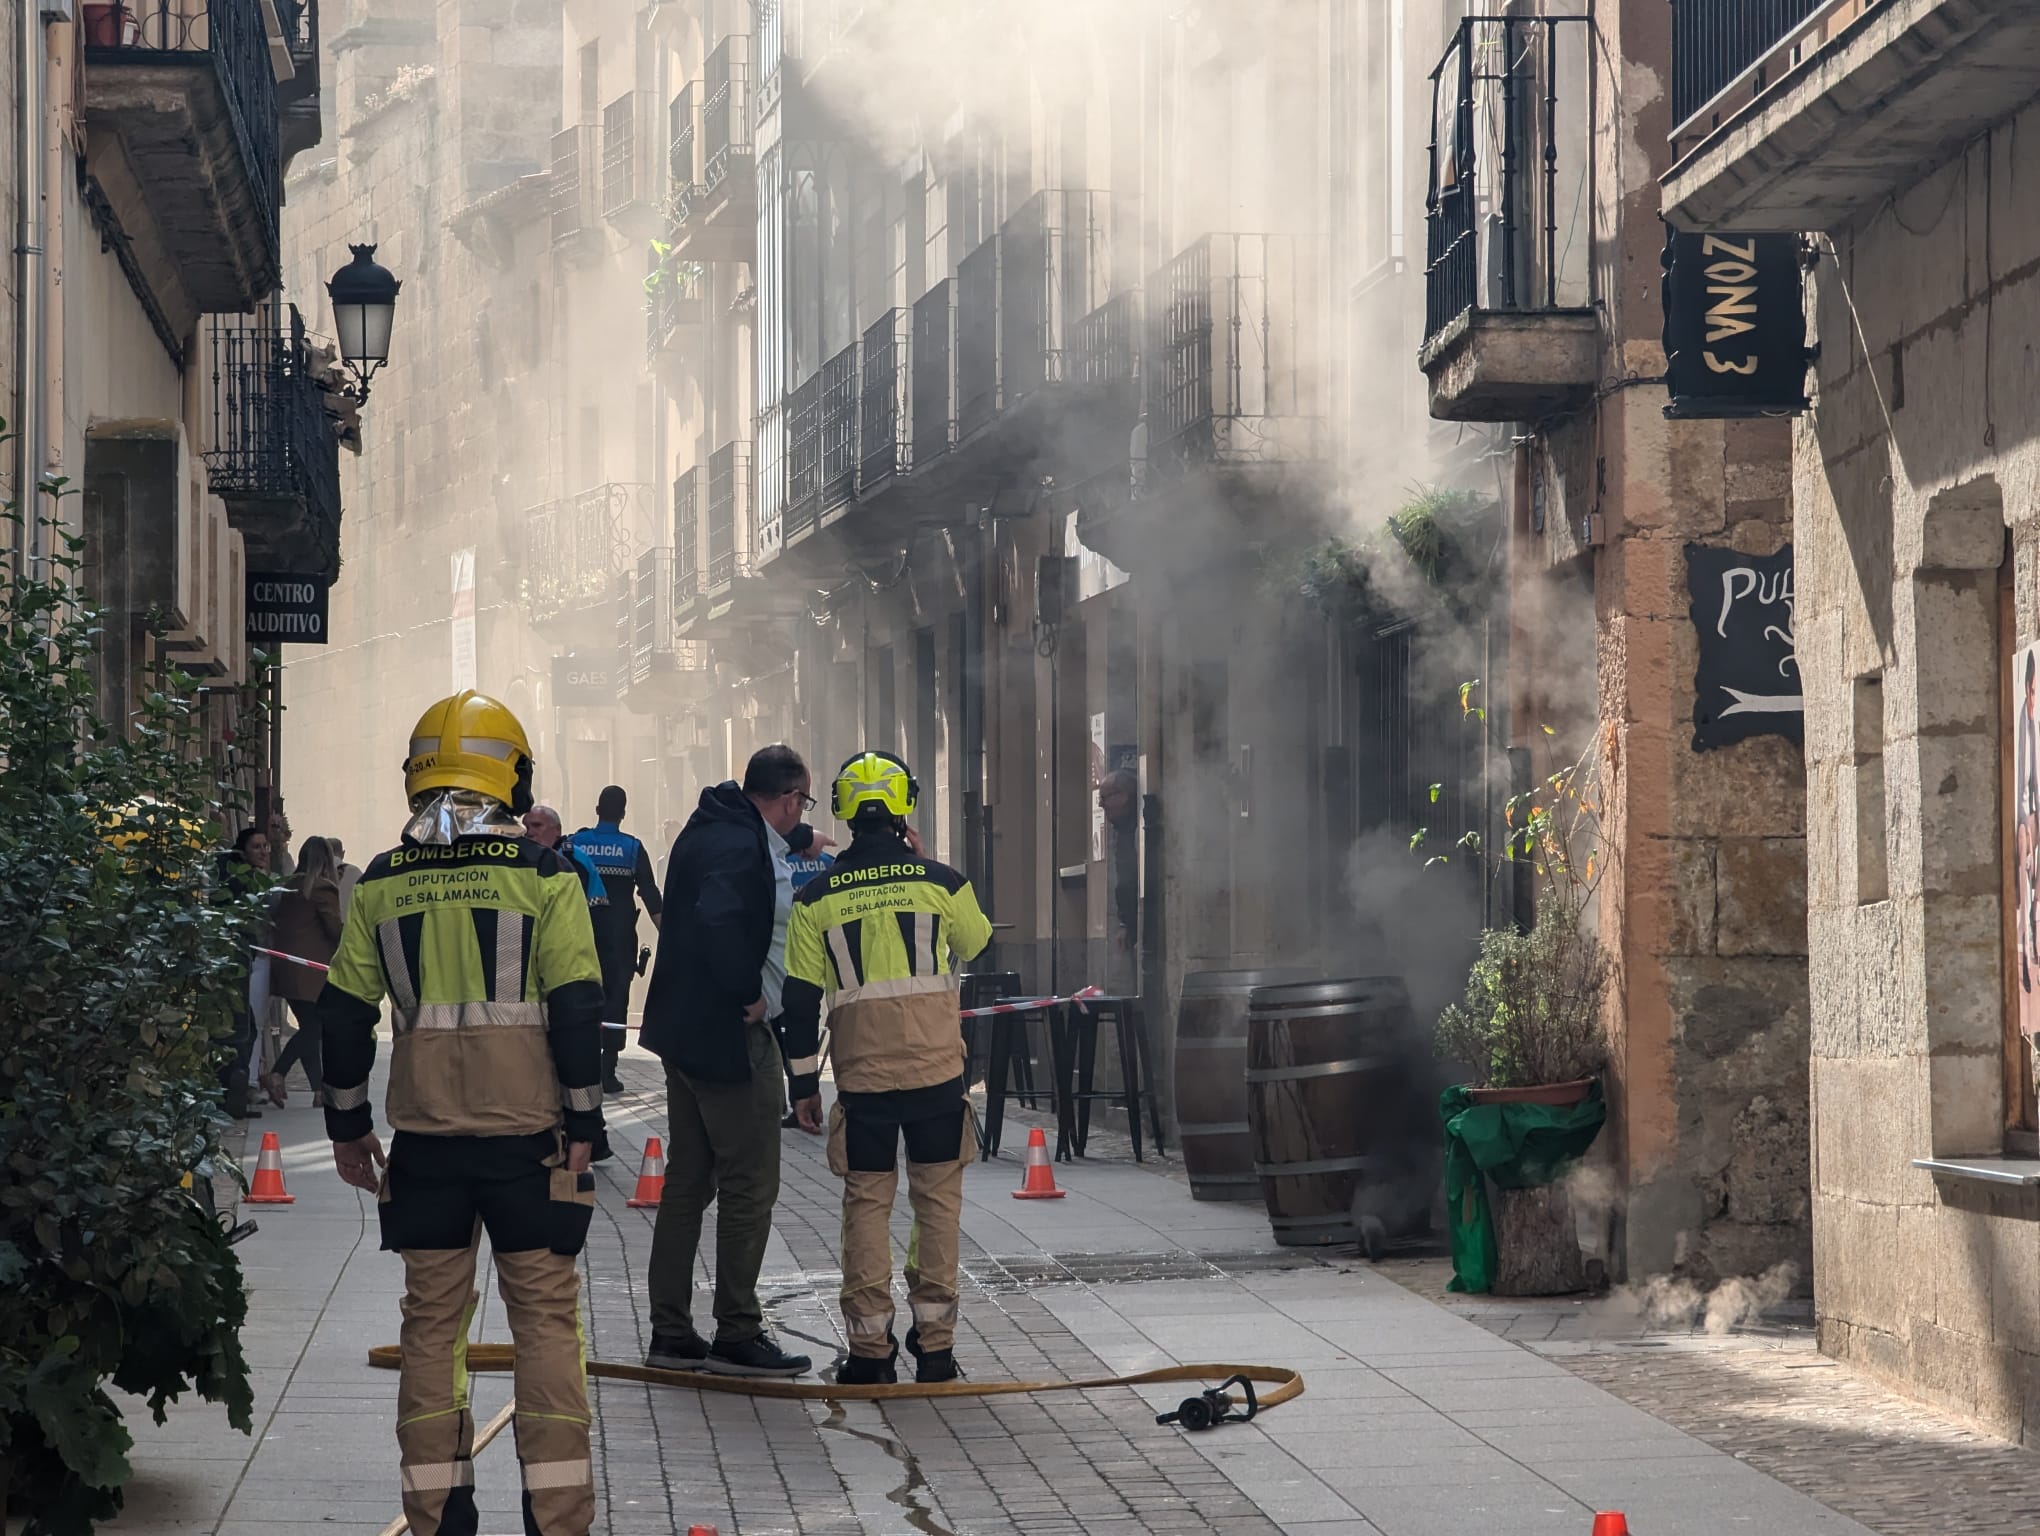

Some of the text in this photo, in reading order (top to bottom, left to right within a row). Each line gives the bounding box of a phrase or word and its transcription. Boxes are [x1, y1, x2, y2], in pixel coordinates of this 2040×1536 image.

[1702, 233, 1759, 375] ZONA 3
[253, 582, 315, 603] CENTRO
[246, 612, 321, 634] AUDITIVO
[567, 671, 608, 685] GAES
[390, 841, 520, 867] BOMBEROS
[408, 868, 489, 887] DIPUTACIÓN
[829, 863, 927, 889] BOMBEROS
[396, 888, 501, 908] DE SALAMANCA
[848, 884, 906, 901] DIPUTACIÓN
[840, 898, 915, 917] DE SALAMANCA
